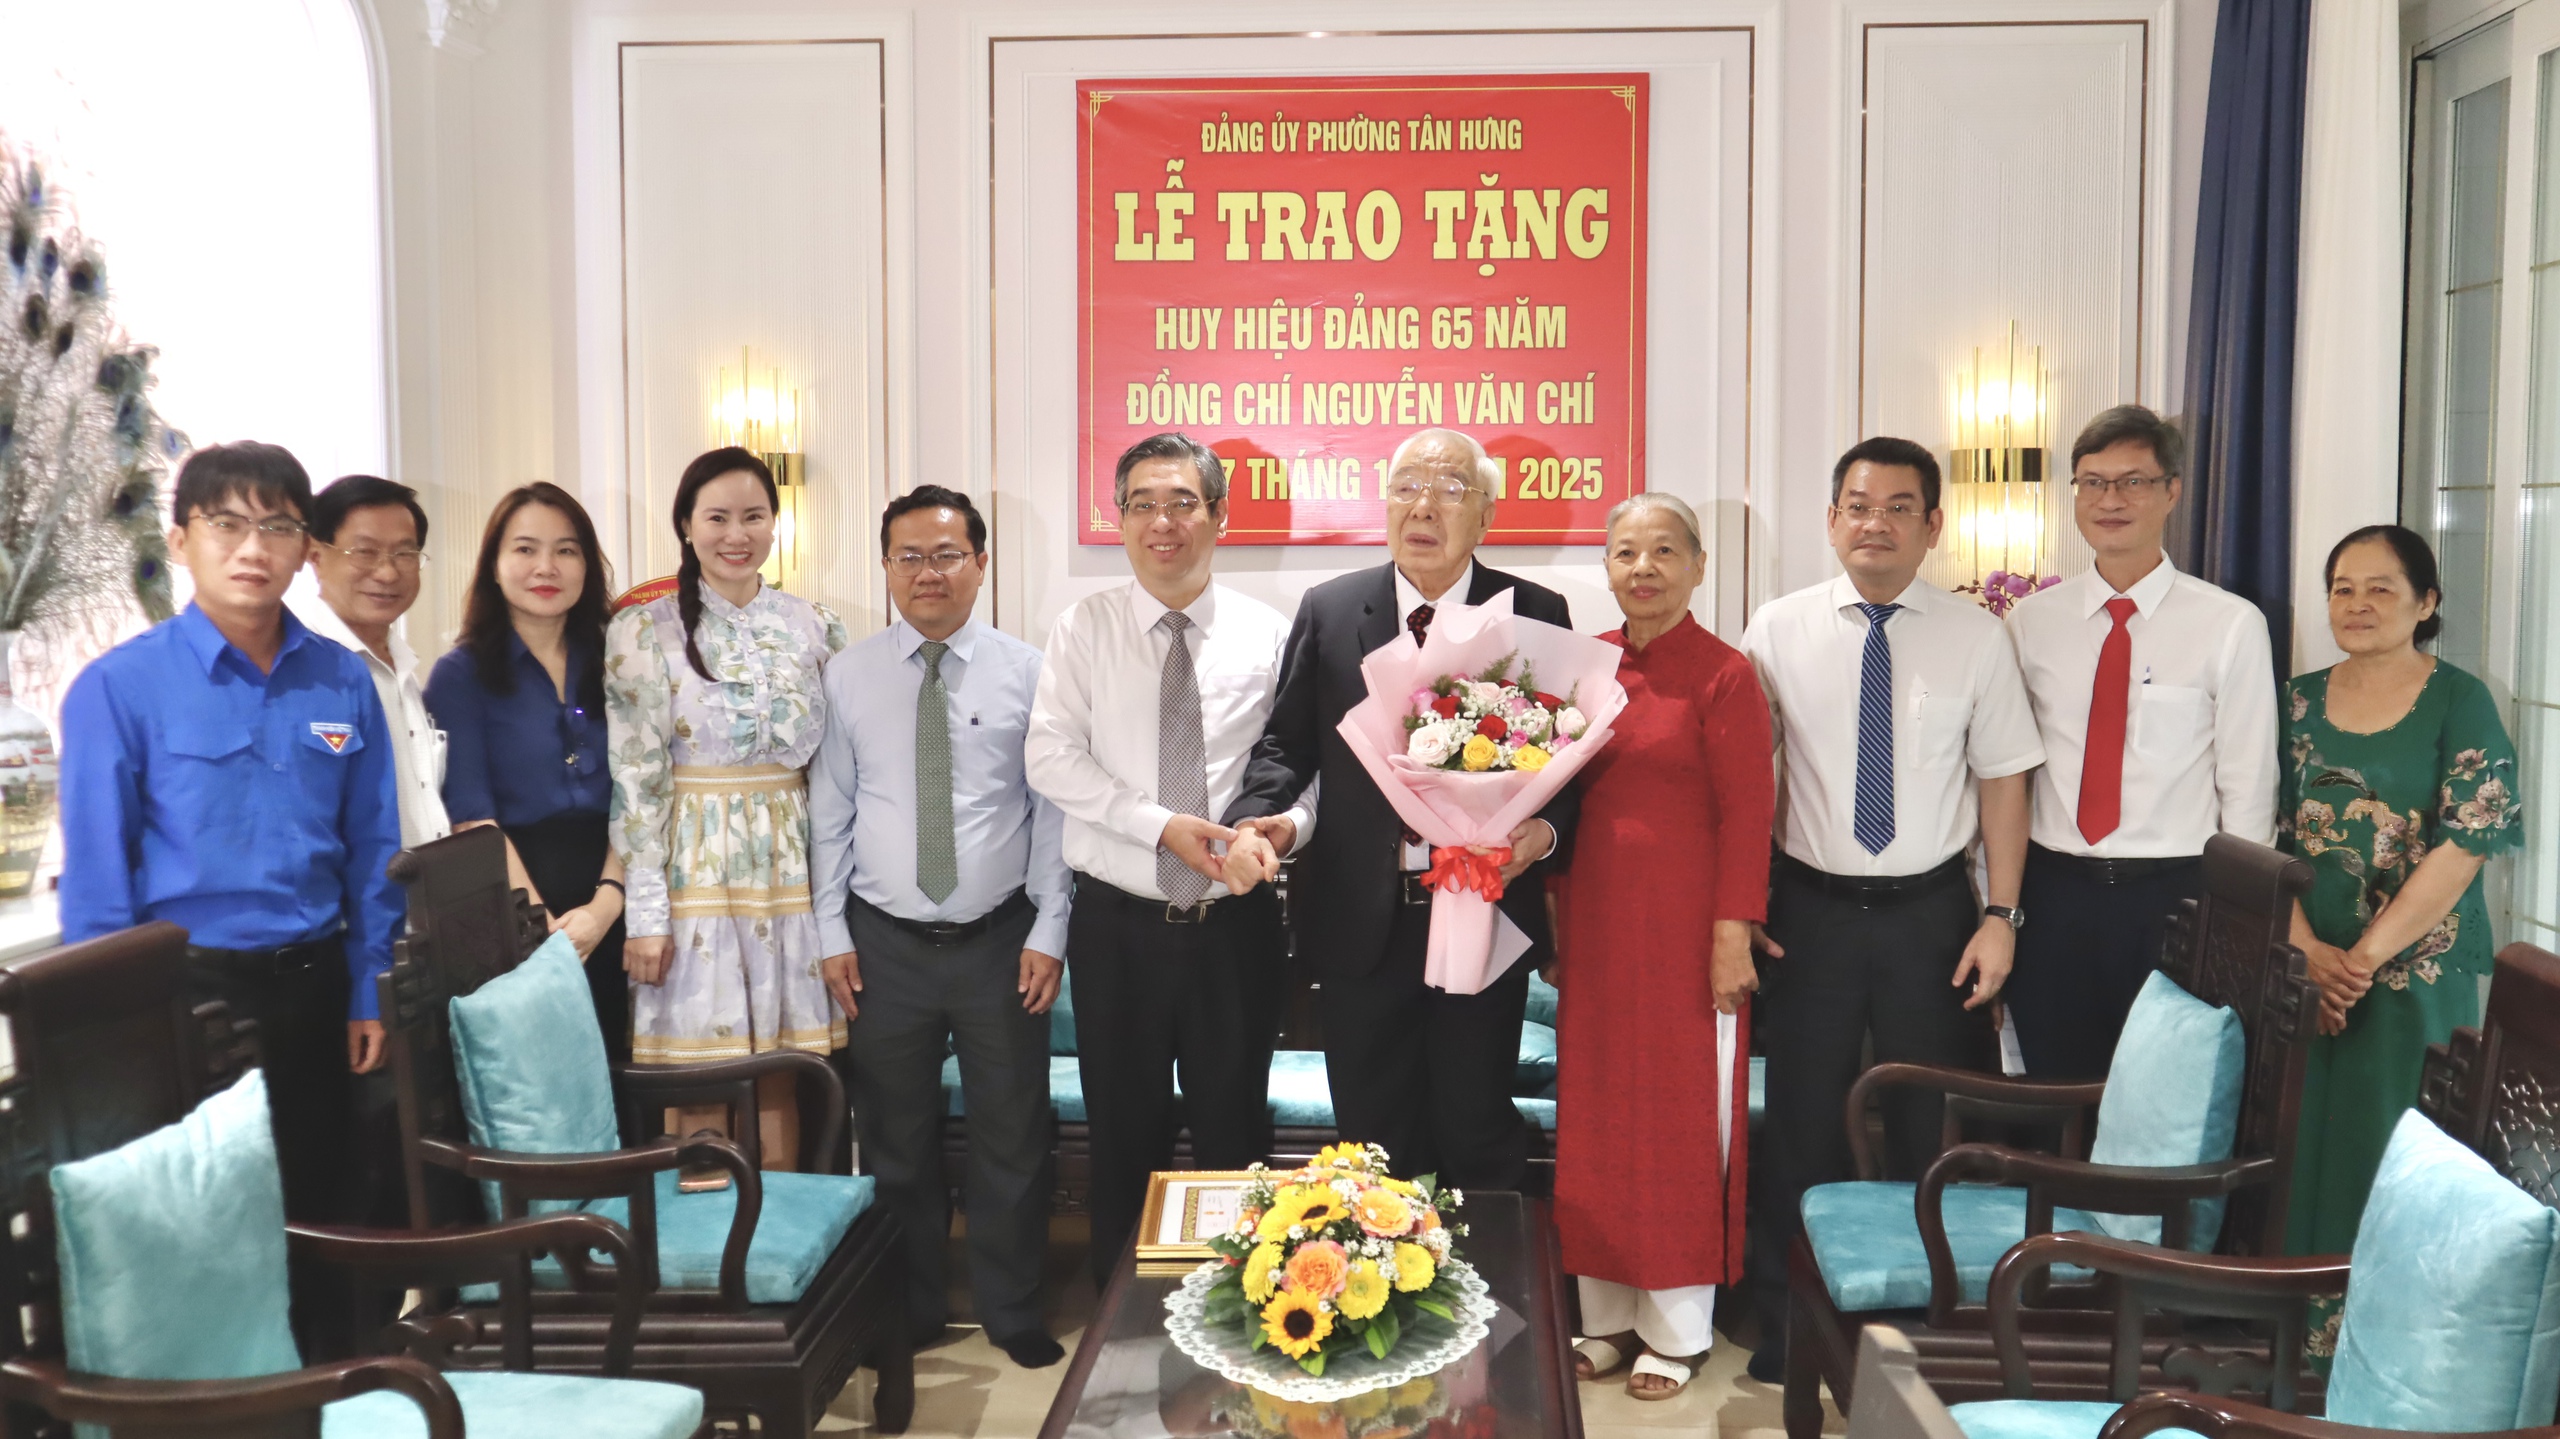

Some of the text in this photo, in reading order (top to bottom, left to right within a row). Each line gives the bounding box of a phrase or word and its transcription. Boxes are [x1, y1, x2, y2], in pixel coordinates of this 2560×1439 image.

[1201, 111, 1522, 153] ĐẢNG ỦY PHƯỜNG TÂN HƯNG
[1114, 158, 1610, 277] LỄ TRAO TẶNG
[1155, 292, 1566, 360] HUY HIỆU ĐẢNG 65 NĂM
[1127, 366, 1595, 425] ĐỒNG CHÍ NGUYỄN VĂN CHÍ
[1219, 458, 1237, 500] 7
[1246, 448, 1361, 501] THÁNG
[1373, 458, 1388, 500] 1
[1518, 457, 1604, 500] 2025
